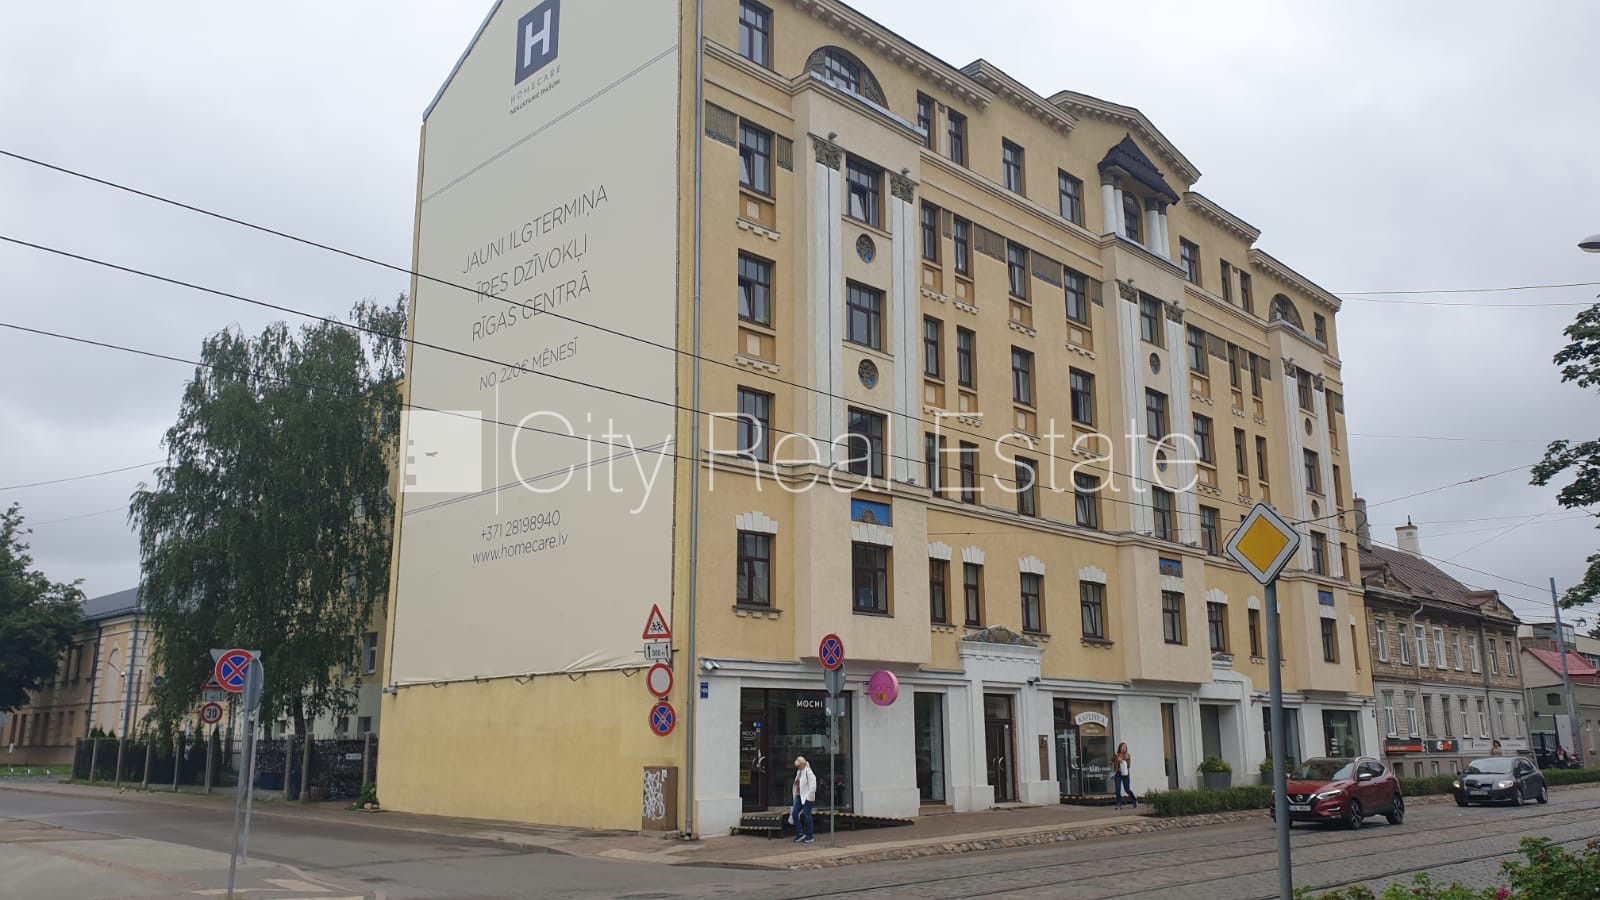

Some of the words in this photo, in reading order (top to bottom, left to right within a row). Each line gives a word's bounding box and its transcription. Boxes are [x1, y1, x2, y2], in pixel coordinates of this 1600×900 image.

[523, 8, 552, 68] H
[510, 64, 561, 104] HOMECARE
[462, 237, 504, 274] JAUNI
[510, 184, 608, 251] ILGTERMIŅA
[476, 272, 509, 304] ĪRES
[513, 233, 587, 286] DZĪVOKĻI
[472, 306, 517, 342] RĪGAS
[522, 270, 591, 319] CENTRĀ
[479, 371, 497, 391] NO
[500, 359, 529, 383] 220€
[532, 336, 579, 369] MĒNESĪ
[472, 531, 569, 564] www.homecare.lv
[481, 523, 503, 541] +371
[505, 509, 561, 537] 28198940
[206, 708, 218, 719] 30
[796, 699, 823, 708] MOCHI
